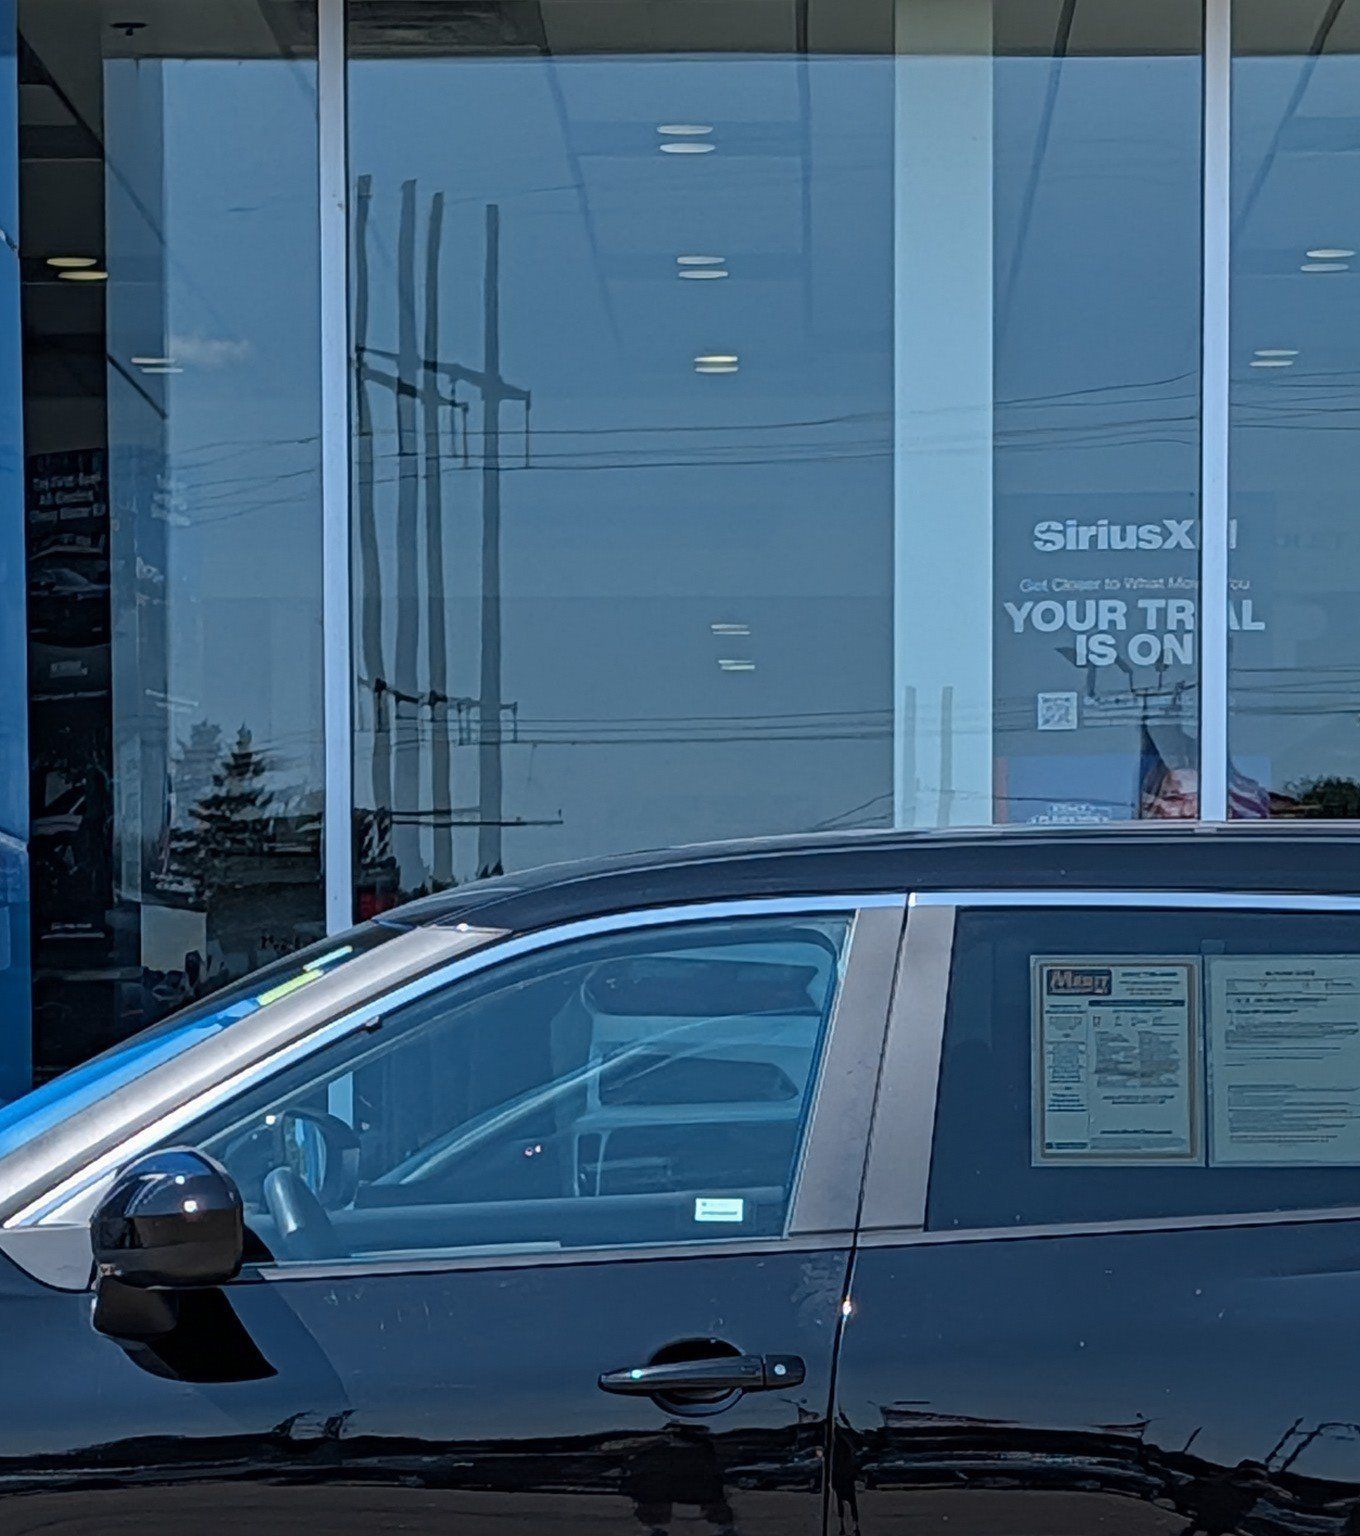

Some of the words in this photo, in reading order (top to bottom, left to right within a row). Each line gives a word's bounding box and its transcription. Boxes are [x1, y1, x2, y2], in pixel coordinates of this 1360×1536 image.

[1033, 519, 1237, 551] SiriusX
[1004, 600, 1127, 633] YOUR
[1076, 634, 1117, 666] IS
[1128, 634, 1194, 665] ON
